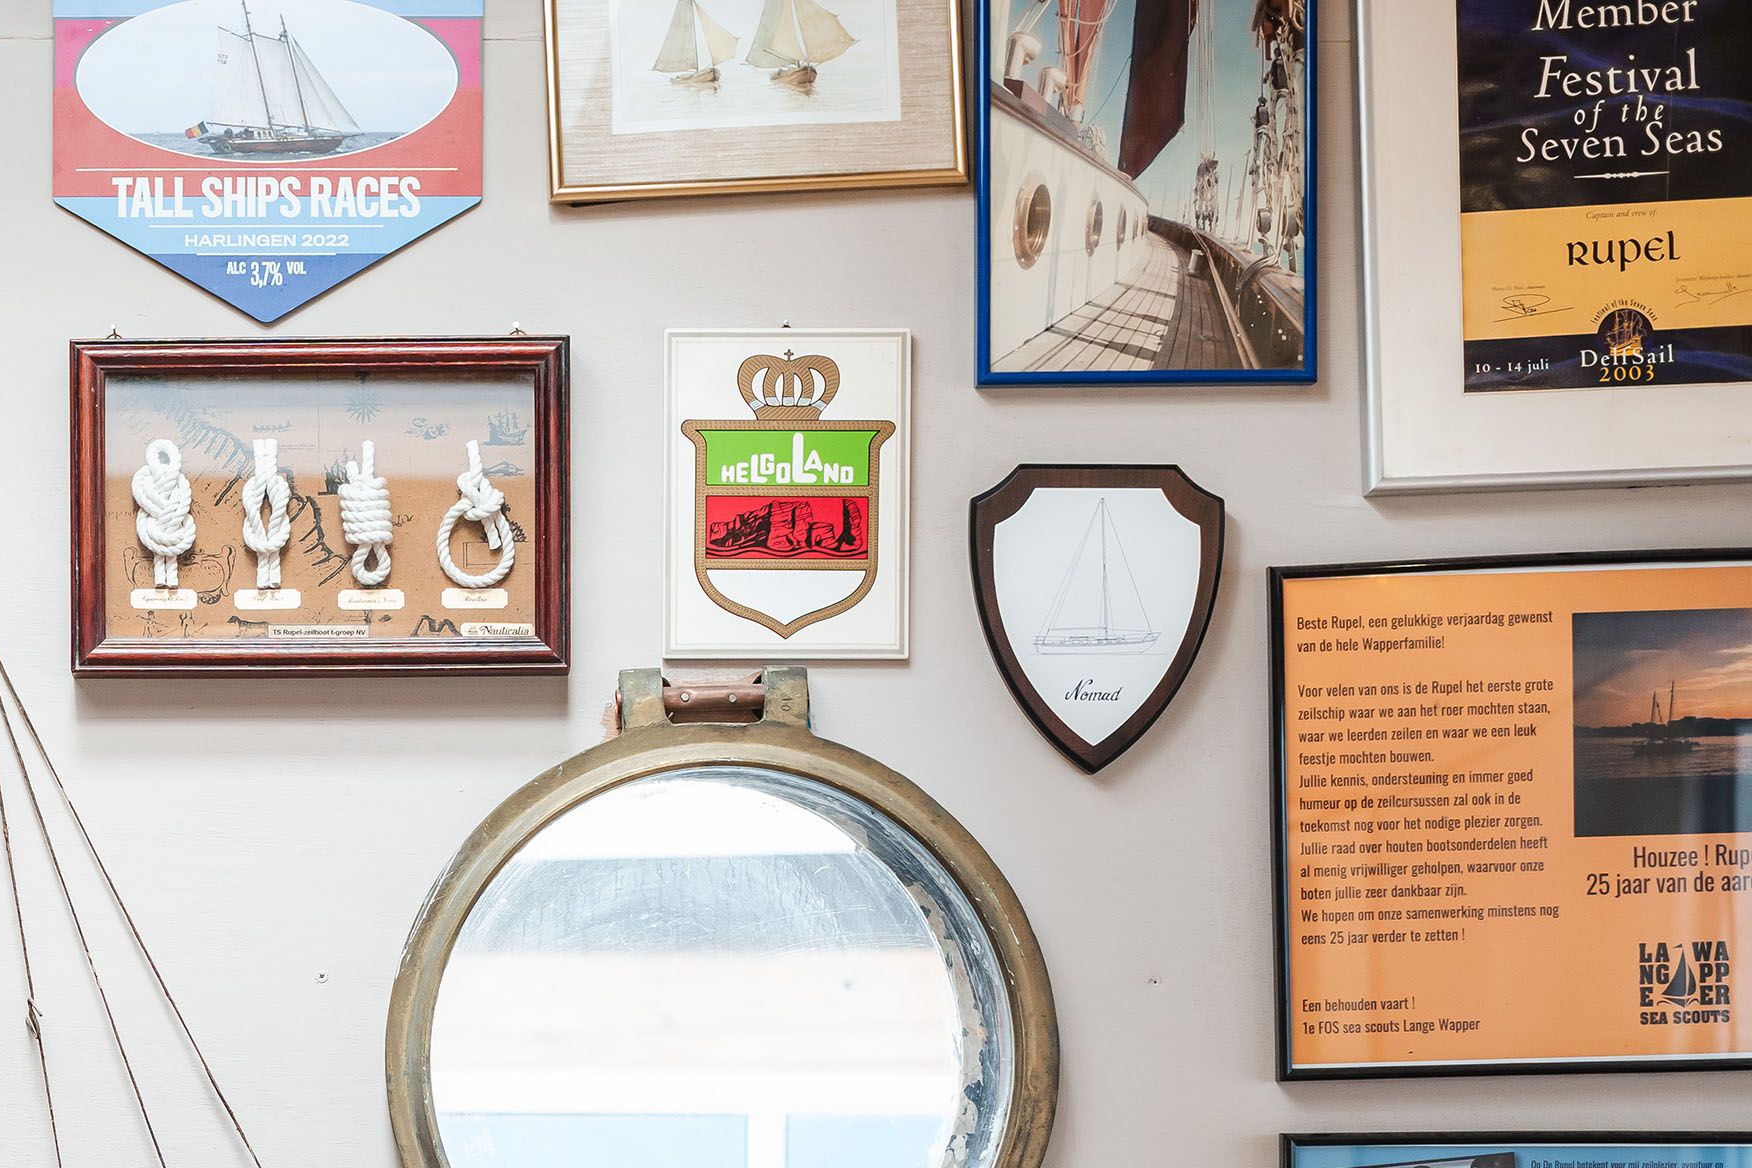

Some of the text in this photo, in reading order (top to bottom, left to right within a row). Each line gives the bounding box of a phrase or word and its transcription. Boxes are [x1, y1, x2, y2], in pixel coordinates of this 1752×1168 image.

[1531, 0, 1698, 31] Member
[1533, 48, 1701, 98] Festival
[1574, 95, 1664, 133] of the
[1516, 121, 1723, 163] Seven Seas
[112, 176, 422, 218] TALL SHIPS RACES
[1586, 209, 1614, 222] Captain
[184, 234, 350, 247] HARLINGEN 2022
[227, 261, 247, 274] ALC
[250, 261, 283, 288] 3,7%
[1527, 358, 1549, 375] juli
[1599, 365, 1655, 382] 2003
[721, 432, 854, 484] HELGOLAND
[479, 625, 530, 636] Nauticalia
[1297, 611, 1552, 631] Beste Rupel, een gelukkige verjaardag gewenst
[1297, 636, 1444, 652] van de hele Wapperfamilie!
[1064, 679, 1124, 701] Nomad
[1298, 678, 1553, 697] Voor velen van ons is de Rupel het eerste grote
[1298, 701, 1550, 722] zeilschip waar we aan het roer mochten staan,
[1298, 723, 1536, 742] waar we leerden zeilen en waar we een leuk
[1633, 846, 1698, 868] Houzee
[1715, 843, 1752, 870] Rup
[1586, 871, 1752, 898] 25 jaar van de aar
[1302, 998, 1320, 1012] Een
[1325, 998, 1376, 1011] behouden
[1380, 997, 1408, 1009] vaart
[1302, 1017, 1480, 1035] 1e FOS sea scouts Lange Wapper
[1639, 1009, 1730, 1025] SEA SCOUTS
